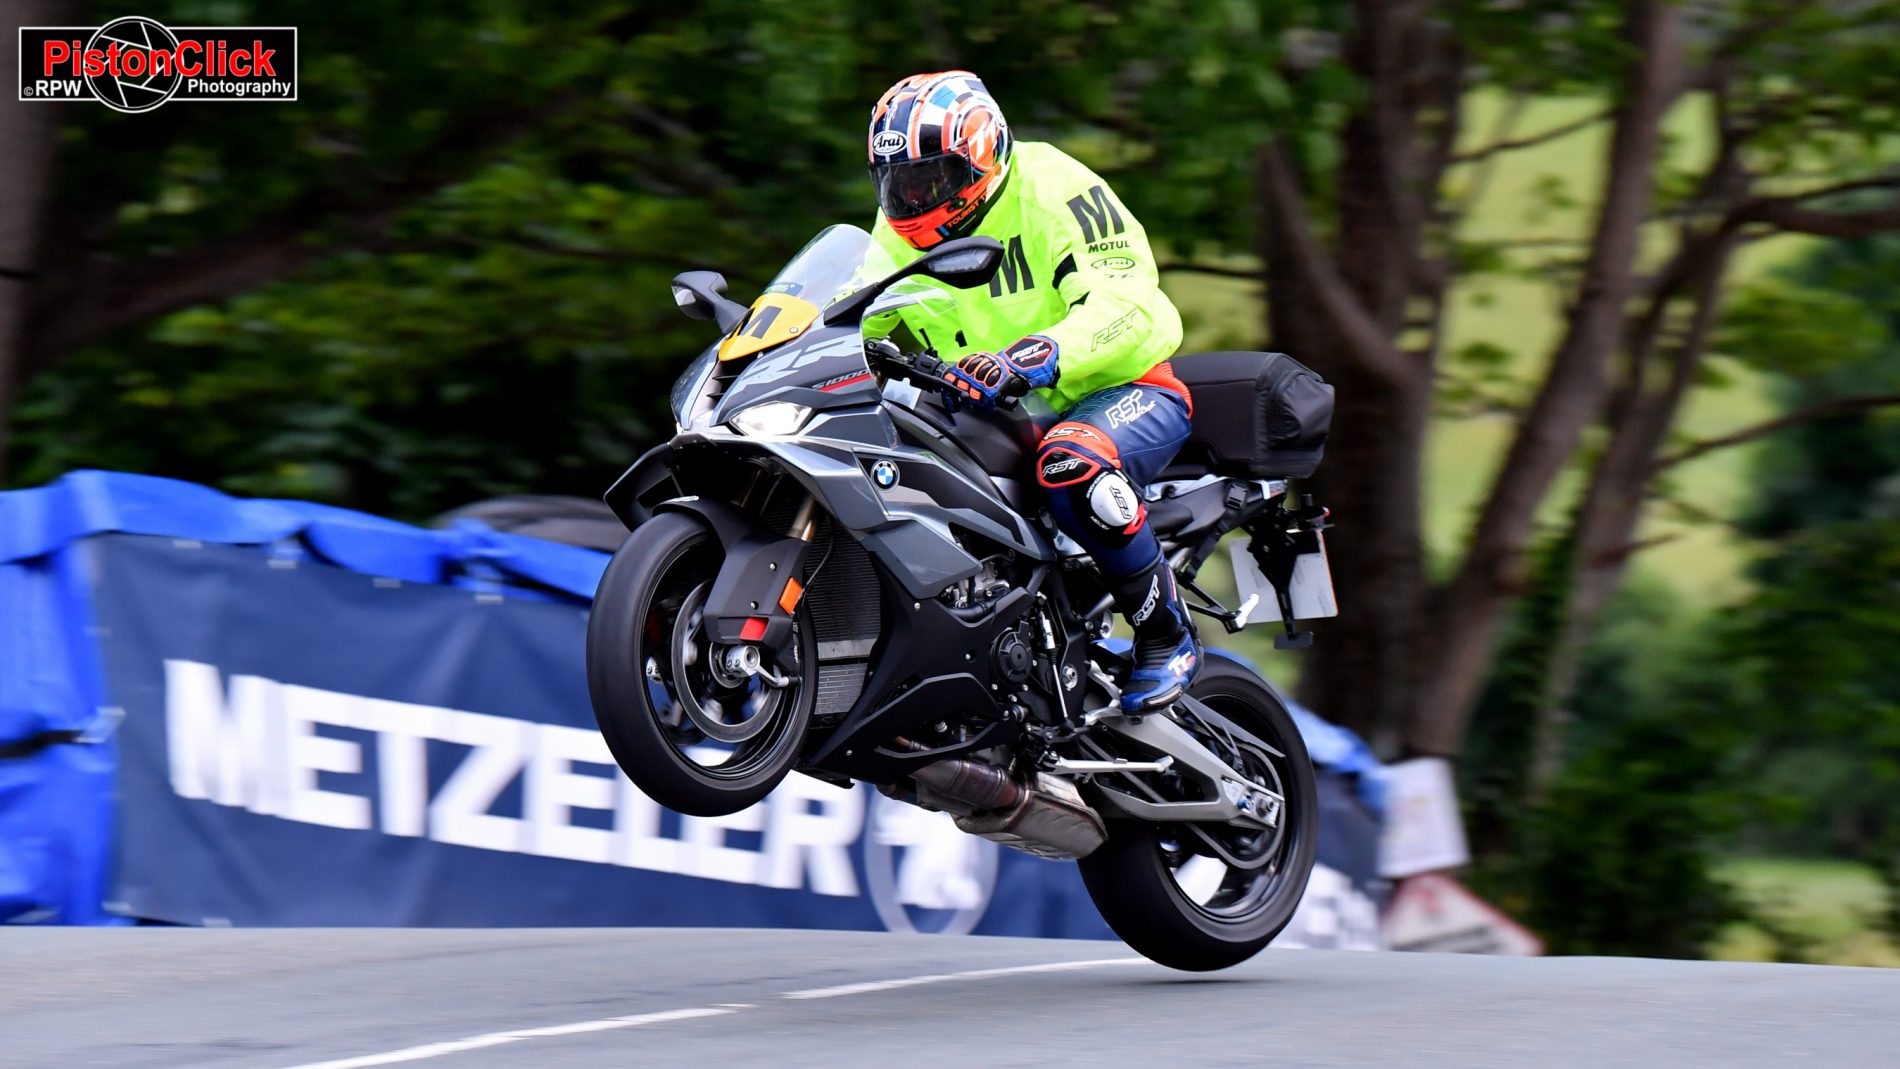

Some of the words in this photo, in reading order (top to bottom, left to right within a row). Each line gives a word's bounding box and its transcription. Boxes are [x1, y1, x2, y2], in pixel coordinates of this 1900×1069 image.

[1066, 185, 1125, 244] M
[1088, 240, 1131, 254] MOTUL
[1042, 457, 1086, 477] RST
[1132, 574, 1161, 627] RST
